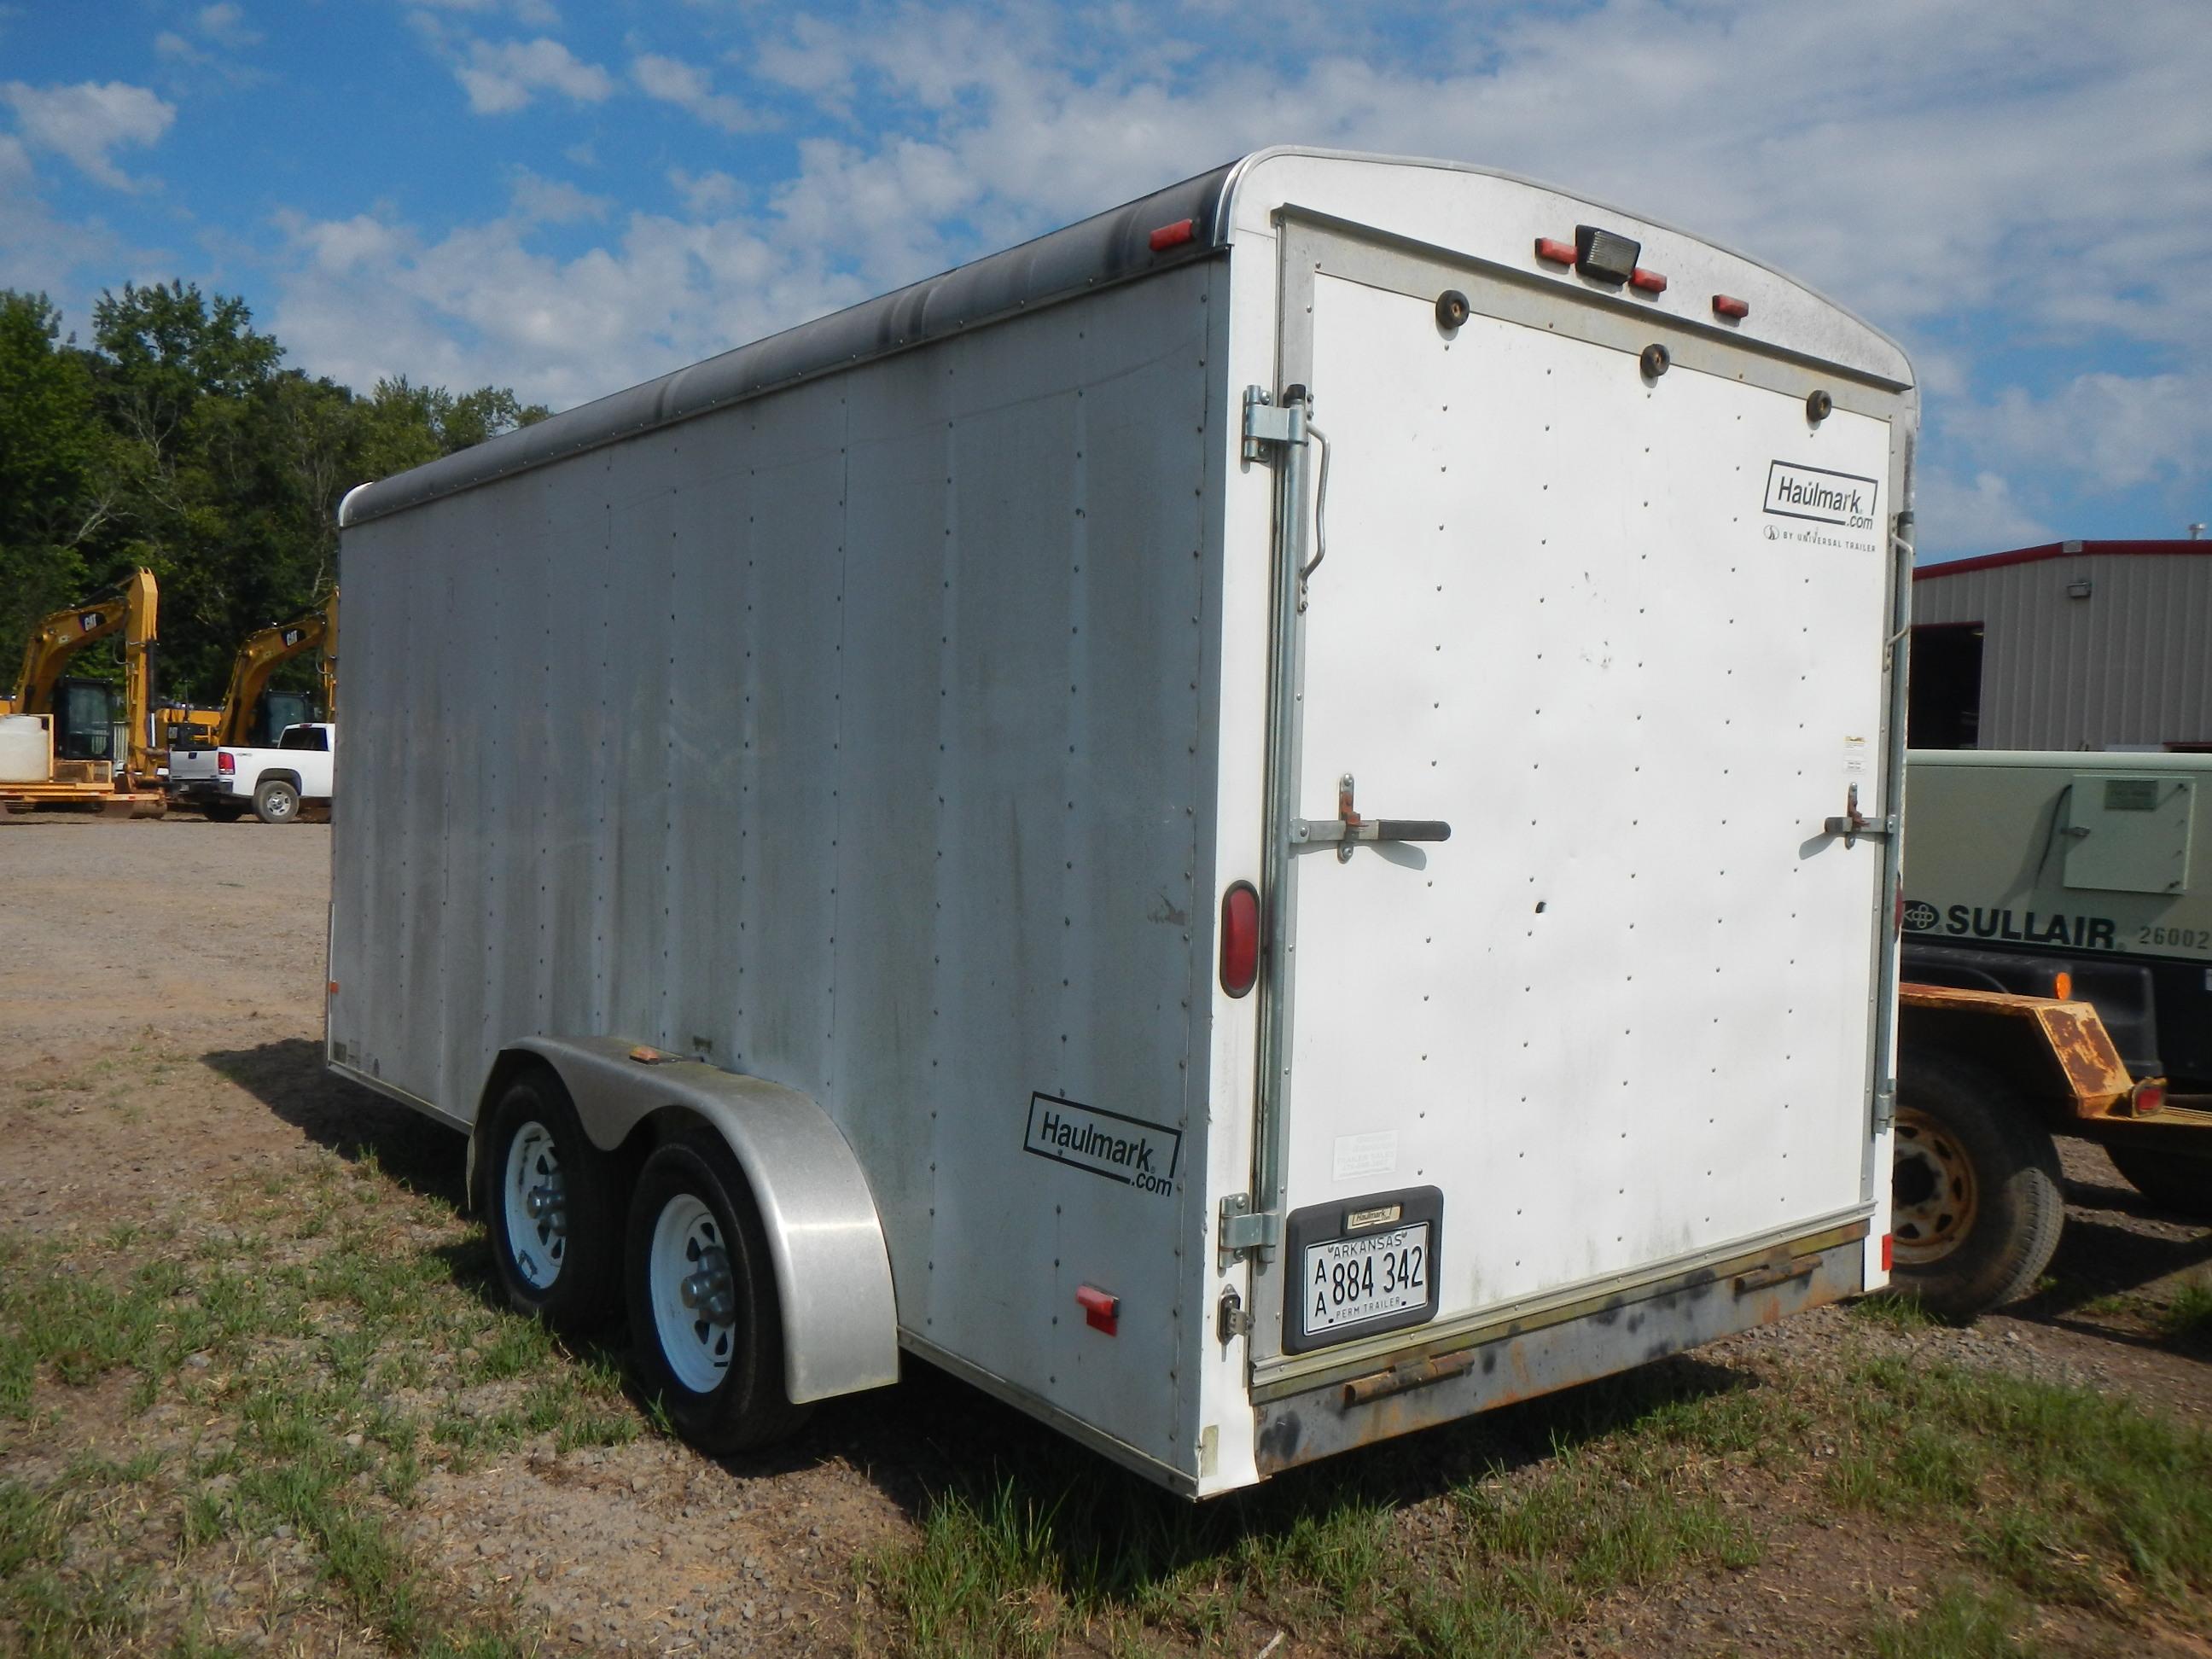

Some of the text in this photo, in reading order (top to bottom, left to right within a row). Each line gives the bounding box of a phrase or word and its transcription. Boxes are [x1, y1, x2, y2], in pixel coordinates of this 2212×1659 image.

[1778, 476, 1861, 514] Haulmark
[1846, 515, 1873, 530] .com
[1783, 531, 1876, 553] BY UNIVERSAL TRAILER
[84, 613, 96, 631] CAT
[286, 630, 298, 646] CAT
[1946, 905, 2116, 949] SULLAIR
[2139, 926, 2210, 949] 26002
[1041, 1111, 1154, 1173] Haulmark
[1131, 1173, 1173, 1197] .com
[1356, 1209, 1385, 1221] Haulmark
[1333, 1233, 1402, 1260] ARKANSAS
[1314, 1259, 1327, 1284] A
[1333, 1246, 1423, 1306] 884 342
[1314, 1291, 1327, 1318] A
[1336, 1296, 1400, 1318] PERM TRAILER
